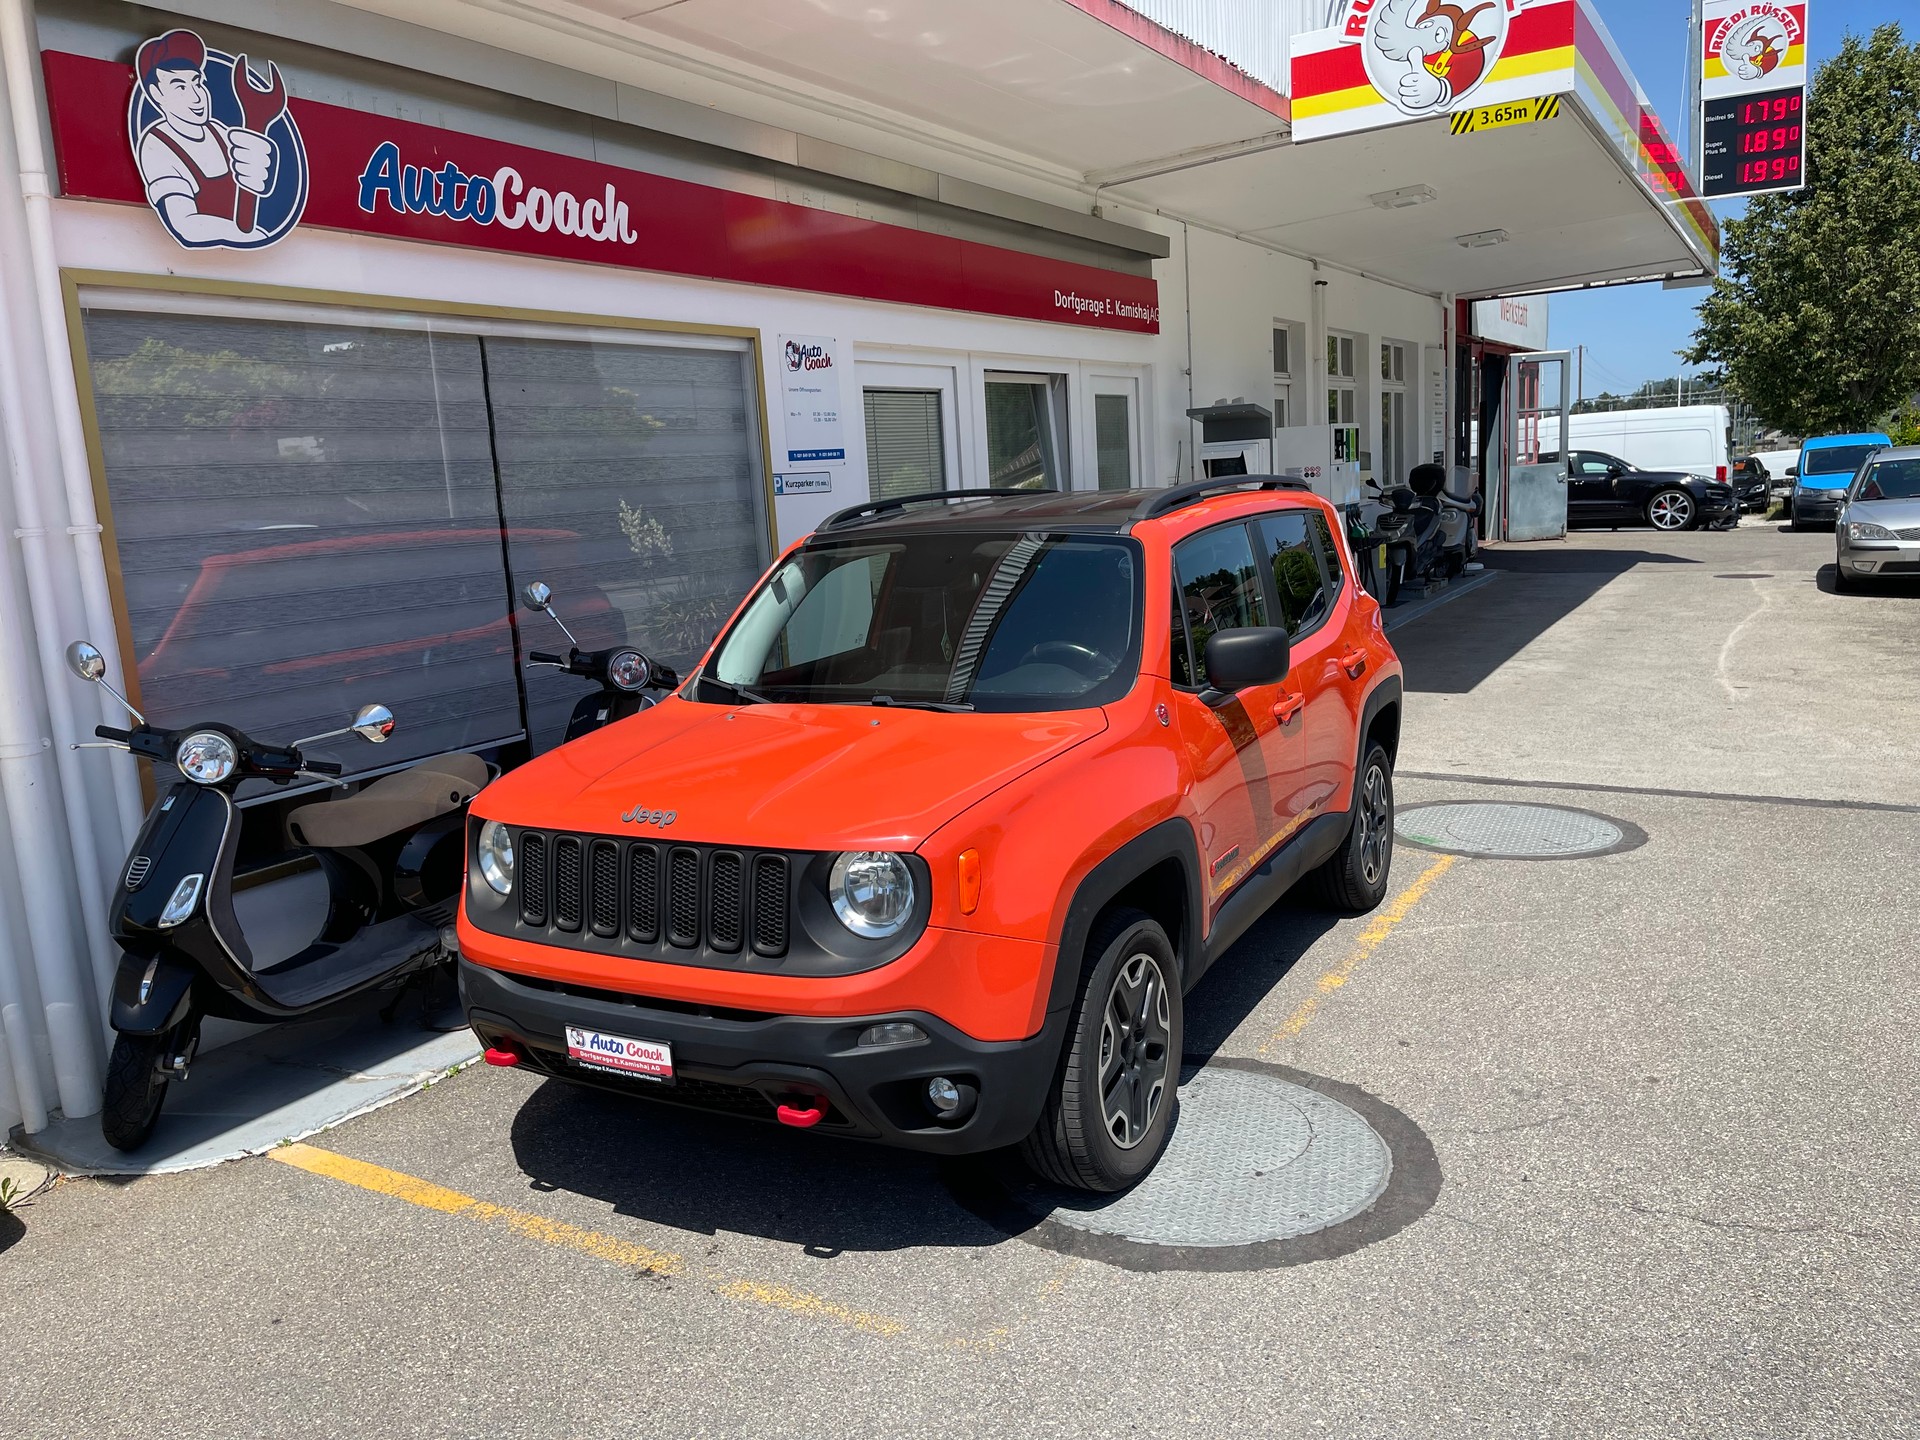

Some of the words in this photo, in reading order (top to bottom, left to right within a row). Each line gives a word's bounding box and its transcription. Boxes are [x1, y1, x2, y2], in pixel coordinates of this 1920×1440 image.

[1712, 9, 1747, 50] RUEDI
[1751, 2, 1798, 41] RÜSSEL
[1481, 106, 1528, 125] 3.65m
[1705, 114, 1727, 123] Bleifrei
[1705, 141, 1723, 149] Super
[1704, 173, 1723, 181] Diesel
[1054, 289, 1104, 318] Dorfgarage
[1106, 298, 1114, 315] E.
[1115, 300, 1150, 325] Kamishaj
[1150, 307, 1160, 322] AG
[1500, 297, 1528, 328] Werkstatt
[801, 344, 822, 360] Auto
[805, 353, 833, 371] Coach
[785, 480, 815, 489] Kurzparker
[621, 804, 678, 829] Jeep
[590, 1033, 624, 1055] Auto
[626, 1042, 665, 1062] Coach
[580, 1051, 613, 1063] Dorfgarage
[579, 1061, 602, 1071] Dorfgarage
